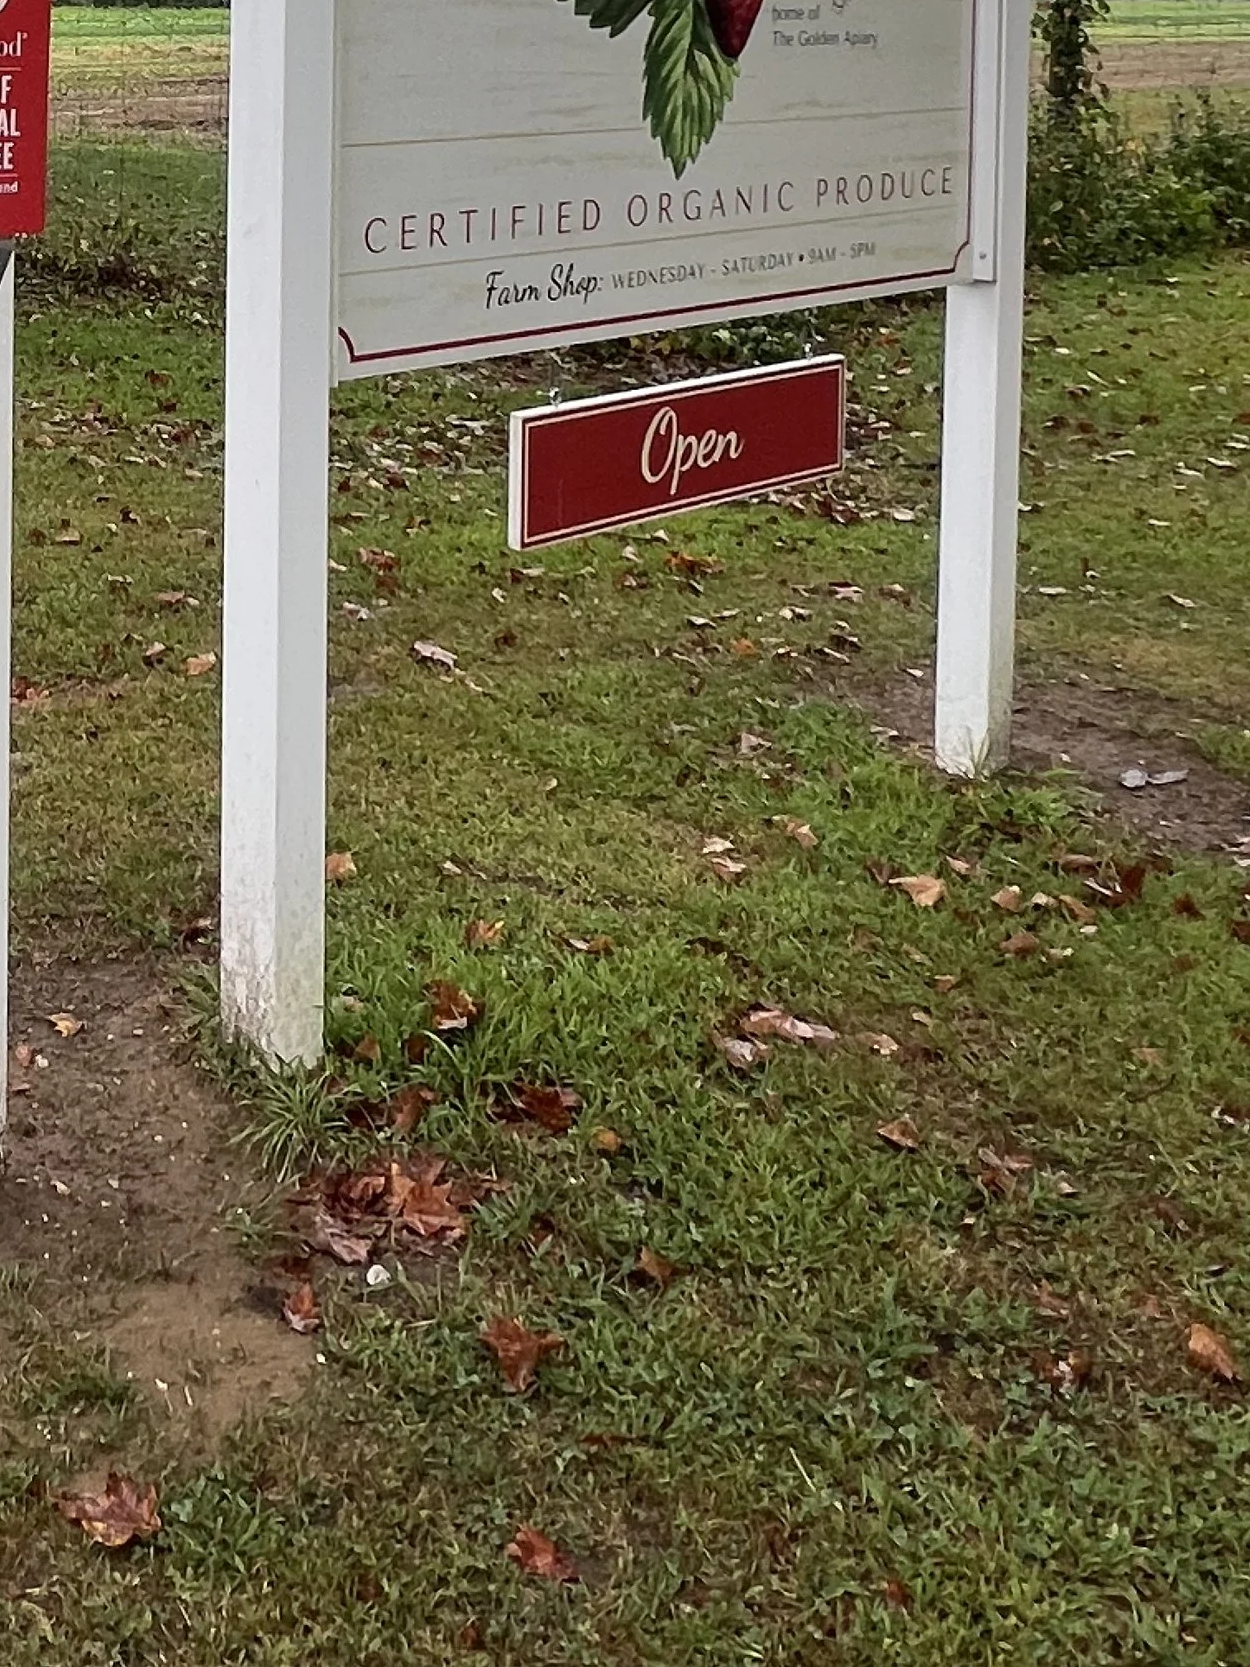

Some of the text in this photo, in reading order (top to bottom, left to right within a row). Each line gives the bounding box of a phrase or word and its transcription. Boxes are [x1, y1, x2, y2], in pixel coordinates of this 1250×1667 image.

[773, 30, 794, 46] The
[798, 30, 840, 46] Golden
[364, 167, 953, 253] CERTIFIED ORGANIC PRODUCE
[486, 270, 541, 309] Farm
[547, 263, 601, 304] Shop:
[611, 263, 705, 290] WEDNESDAY
[721, 252, 794, 277] SATURDAY
[850, 242, 876, 259] 5PM
[641, 406, 745, 495] Open
